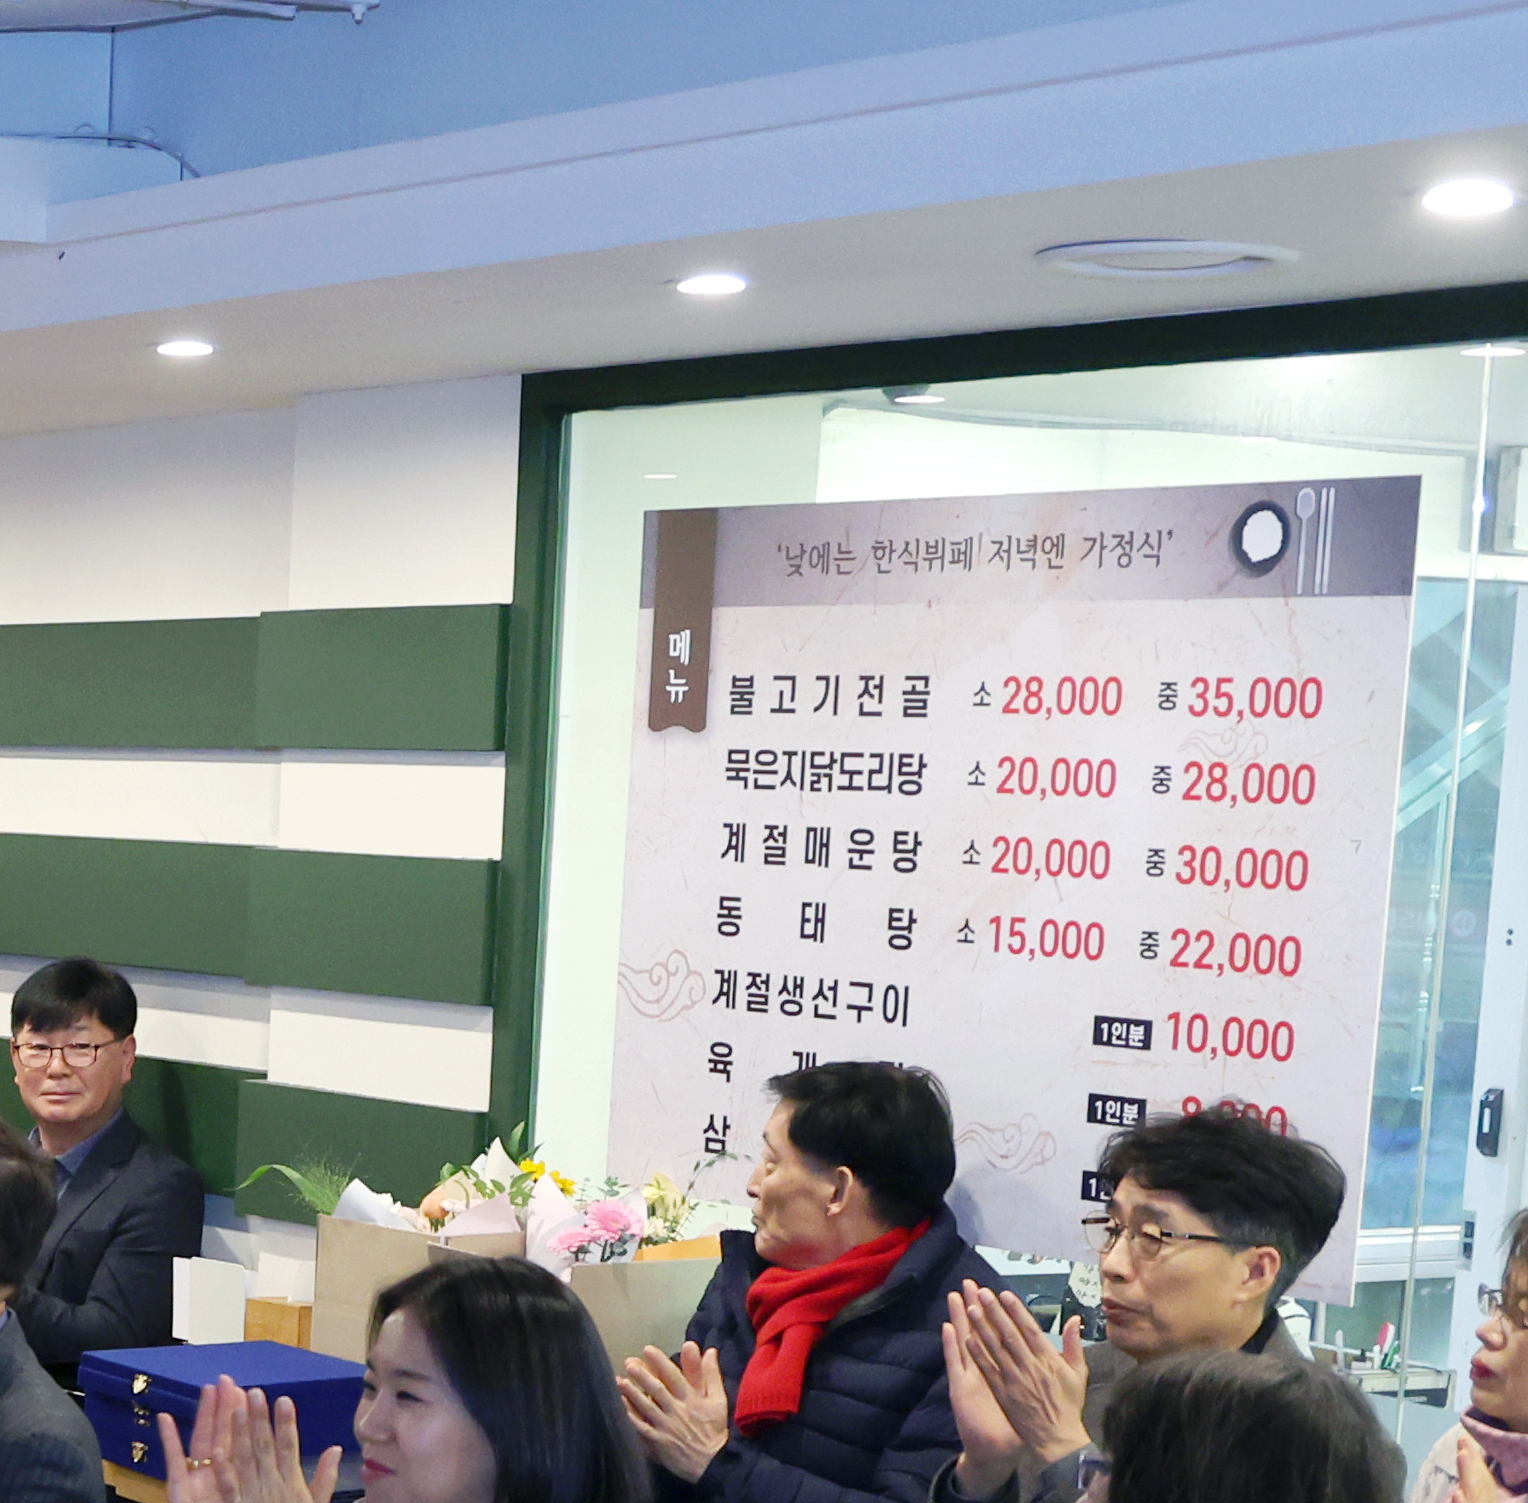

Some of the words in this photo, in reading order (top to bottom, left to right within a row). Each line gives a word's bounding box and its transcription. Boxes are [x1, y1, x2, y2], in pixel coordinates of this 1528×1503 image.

[872, 536, 974, 575] 한식뷔페
[988, 532, 1065, 572] 저녁엔
[665, 628, 692, 704] 메뉴
[972, 680, 992, 709] 소
[1002, 675, 1123, 721] 28,000
[1157, 680, 1179, 712] 중
[1187, 676, 1323, 724] 35,000
[724, 748, 928, 797] 묵은지닭도리탕
[967, 760, 987, 787] 소
[996, 755, 1117, 801] 20,000
[1151, 764, 1173, 795] 중
[1182, 761, 1317, 809] 28,000
[962, 838, 981, 866] 소
[991, 835, 1112, 883] 20,000
[1145, 847, 1167, 879] 중
[1175, 844, 1310, 894] 30,000
[956, 917, 976, 945] 소
[989, 914, 1106, 962] 15,000
[1139, 929, 1161, 961] 중
[1169, 928, 1303, 978] 22,000
[711, 967, 911, 1028] 계절생선구이
[1100, 1021, 1146, 1048] 1인분
[1166, 1010, 1295, 1063] 10,000
[1094, 1099, 1140, 1127] 1인분
